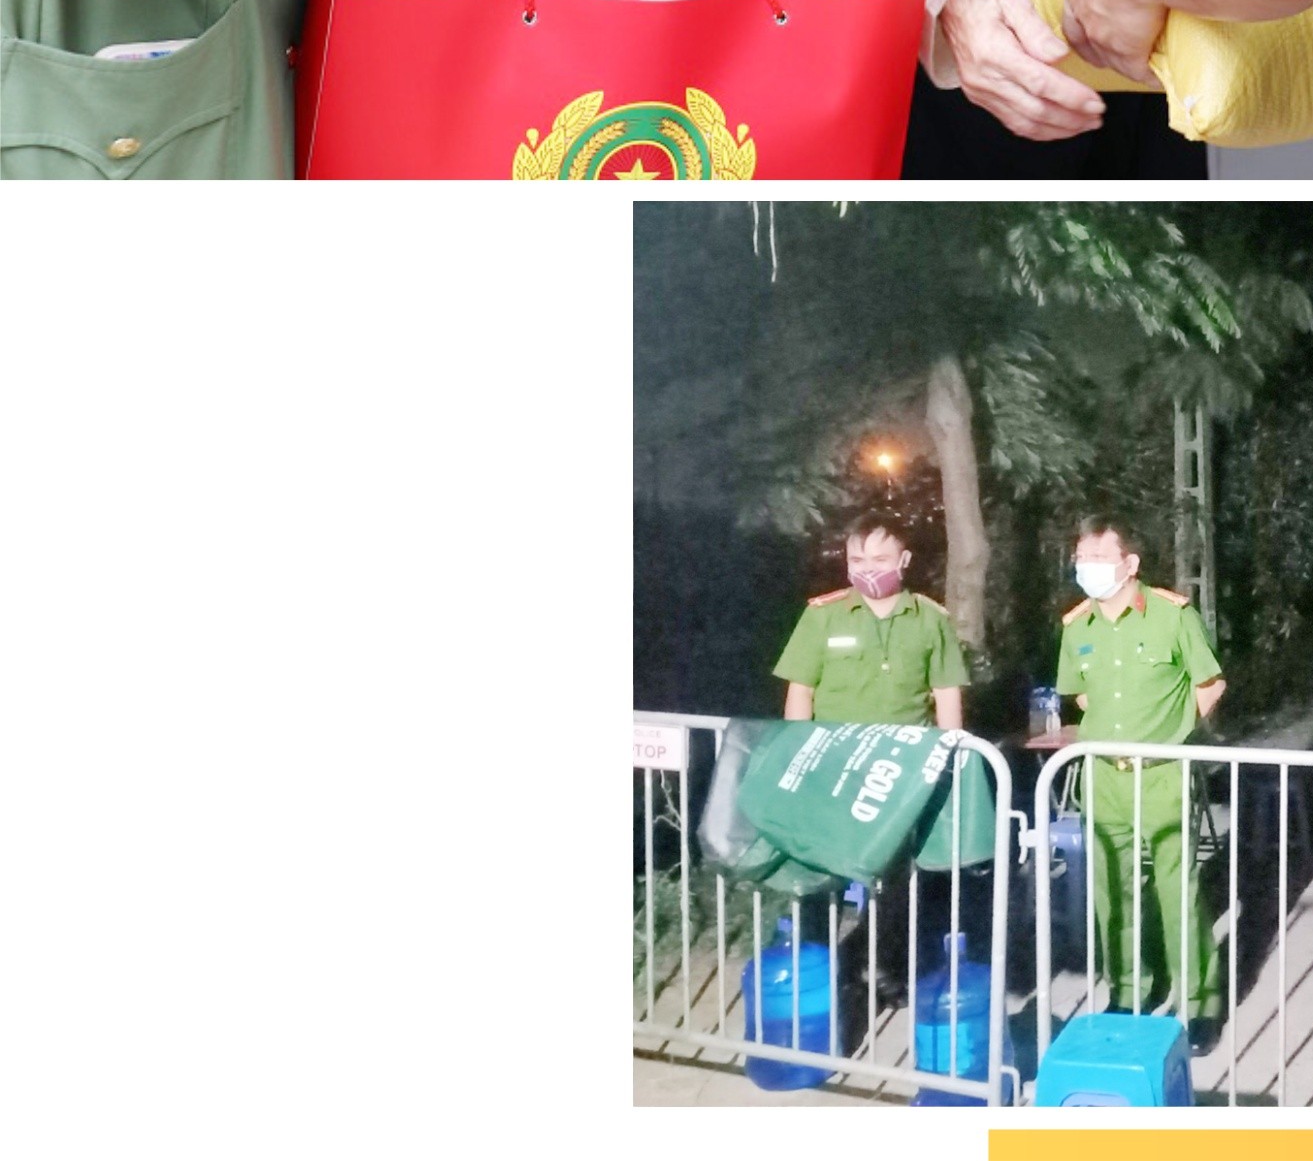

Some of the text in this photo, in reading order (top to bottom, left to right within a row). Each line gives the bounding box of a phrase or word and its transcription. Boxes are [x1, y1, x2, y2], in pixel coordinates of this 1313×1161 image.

[633, 729, 661, 738] OLICE
[633, 744, 667, 759] TOP
[851, 759, 903, 823] GOLD
